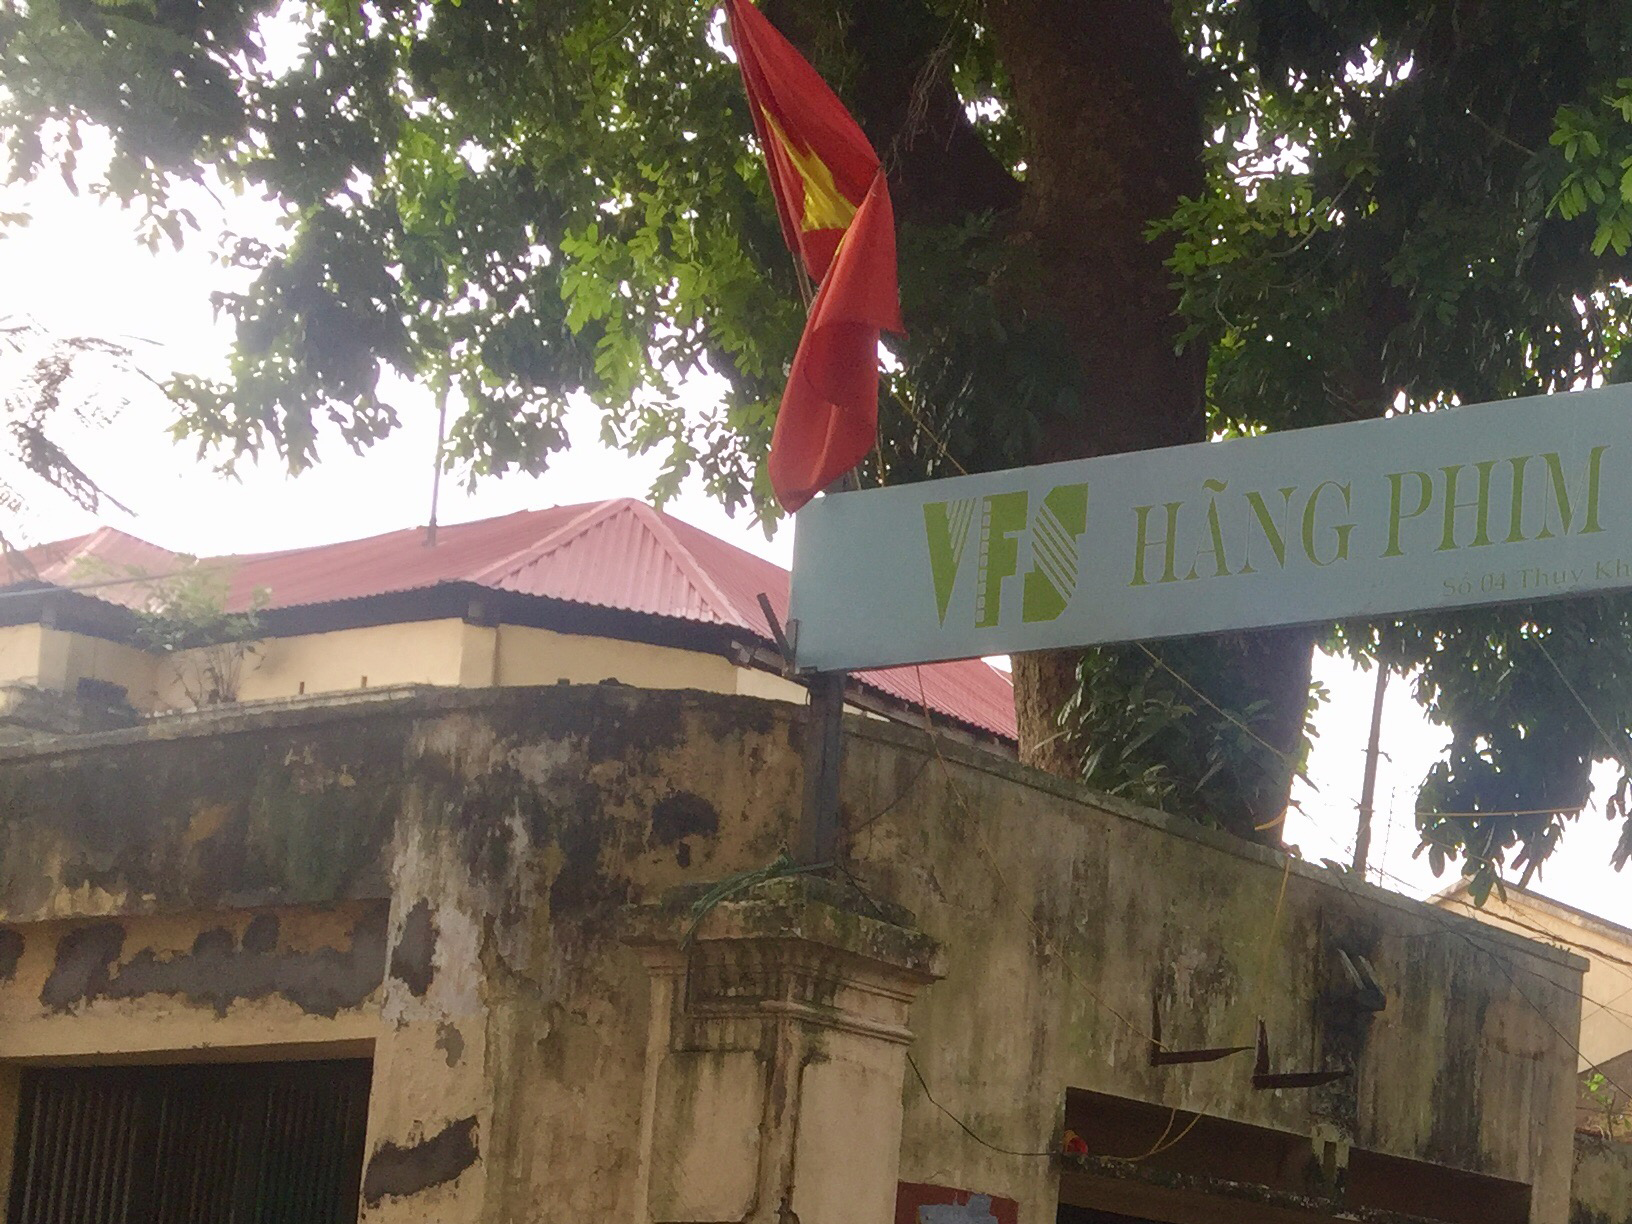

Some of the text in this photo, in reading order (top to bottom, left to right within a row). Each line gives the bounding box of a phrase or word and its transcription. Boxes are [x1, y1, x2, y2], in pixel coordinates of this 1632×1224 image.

[1128, 480, 1358, 587] HÃNG
[1380, 444, 1608, 558] PHIM
[1480, 572, 1506, 593] 04
